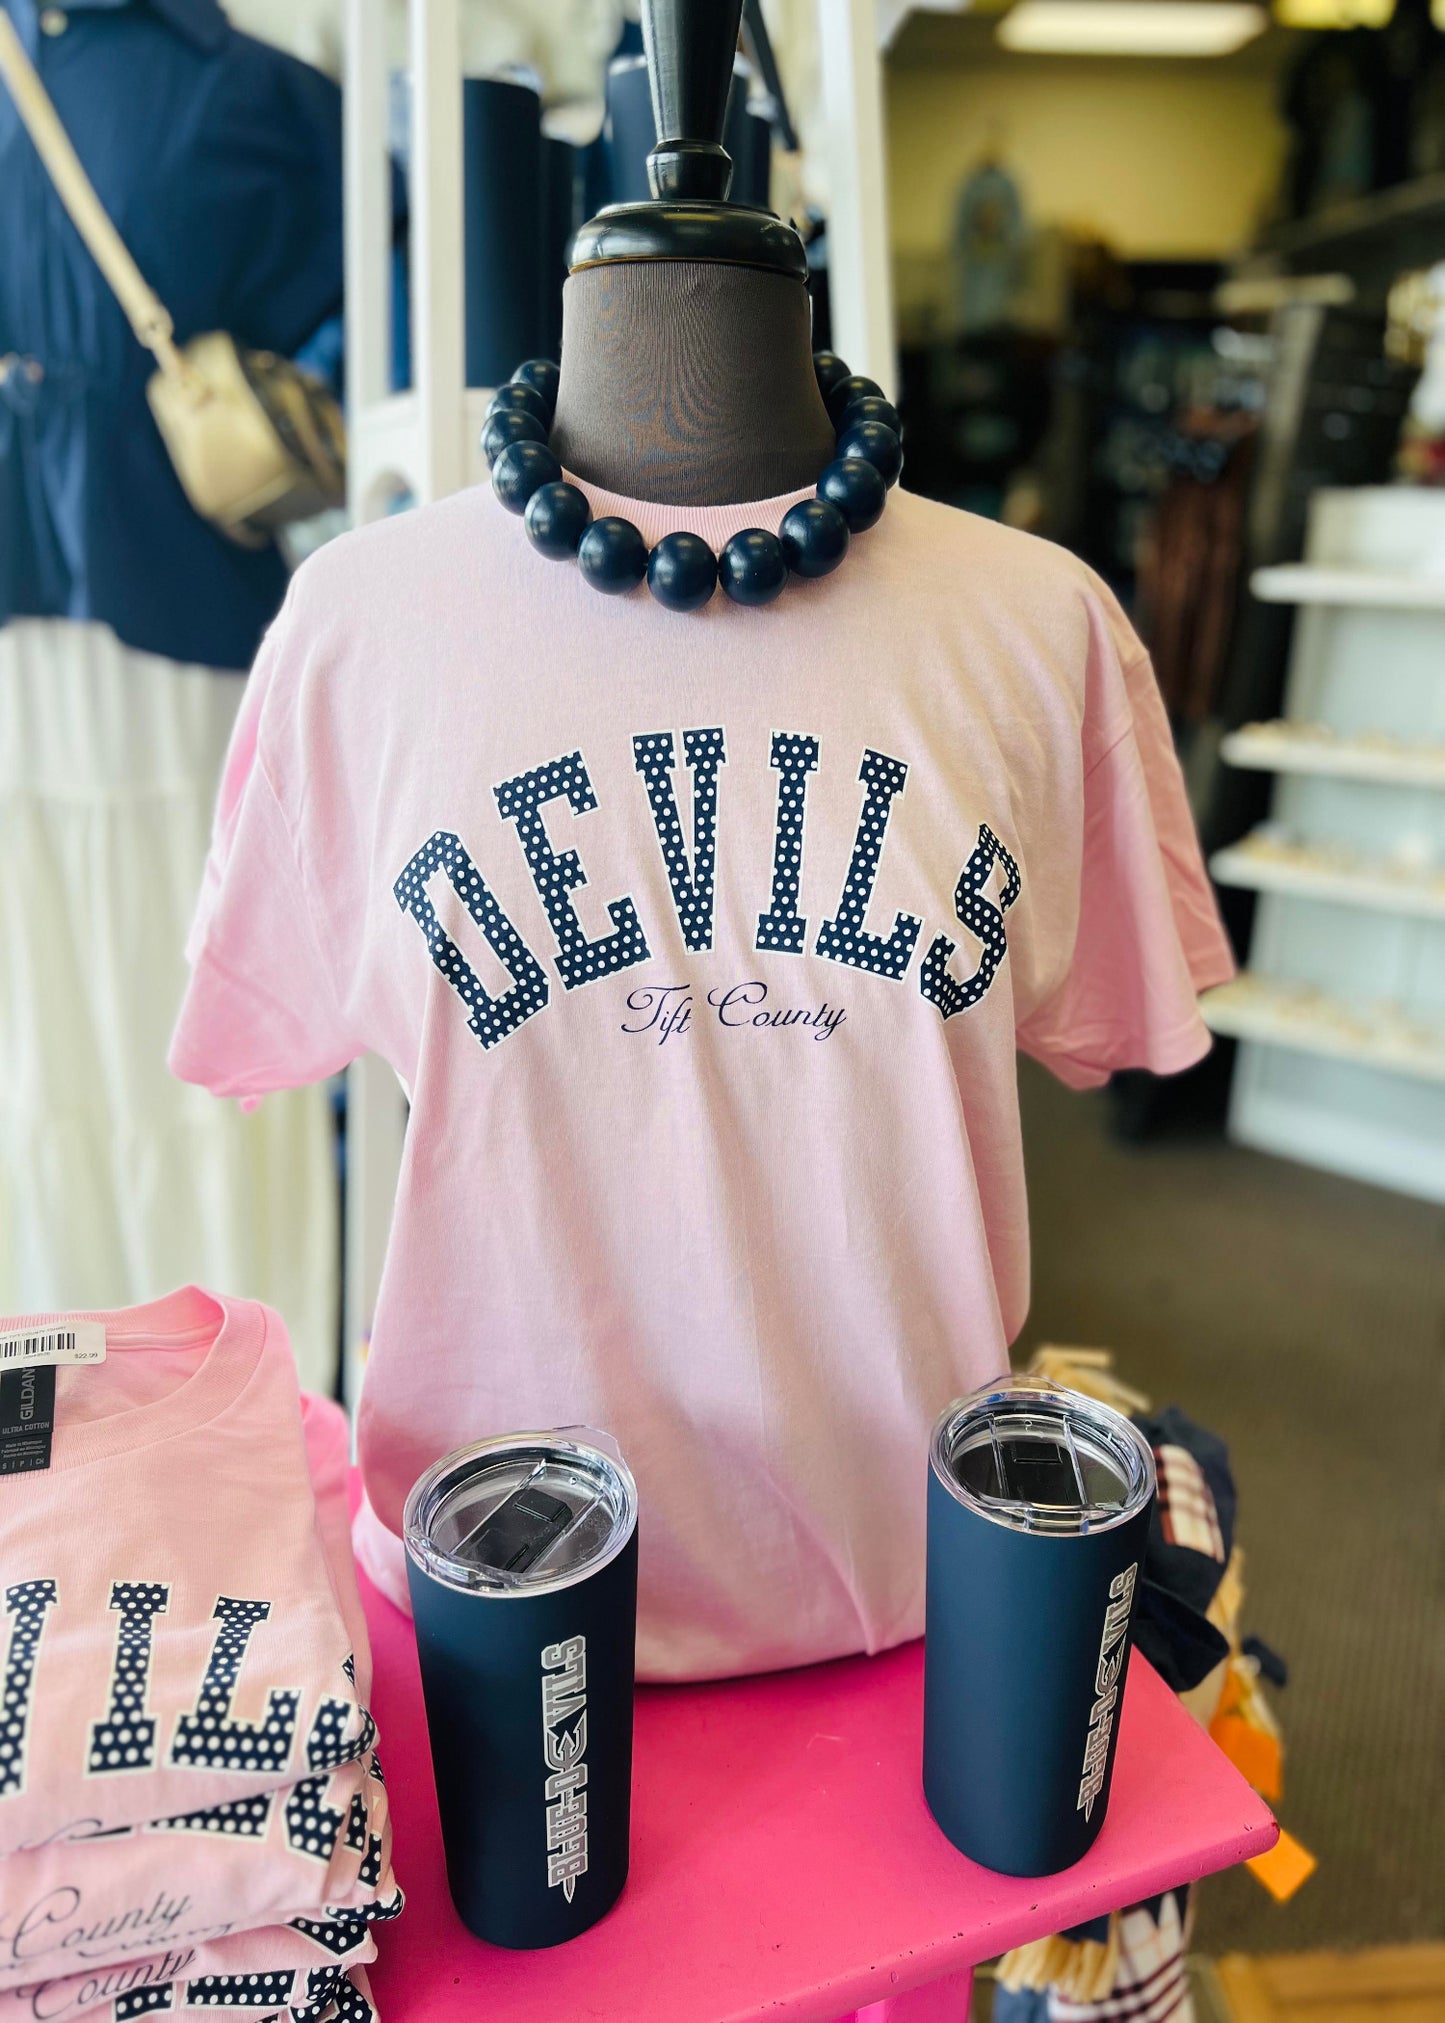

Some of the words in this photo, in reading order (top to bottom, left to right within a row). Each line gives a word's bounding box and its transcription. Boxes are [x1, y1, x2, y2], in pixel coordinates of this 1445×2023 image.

[392, 724, 1022, 1053] DEVILS
[621, 984, 693, 1046] Tift
[707, 981, 847, 1042] County
[2, 1426, 23, 1435] ULTRA
[24, 1421, 50, 1431] COTTON
[20, 1367, 36, 1420] GILDAN
[541, 1634, 589, 1801] DEVILS
[1077, 1713, 1114, 1811] BLUE
[545, 1791, 589, 1889] BLUE
